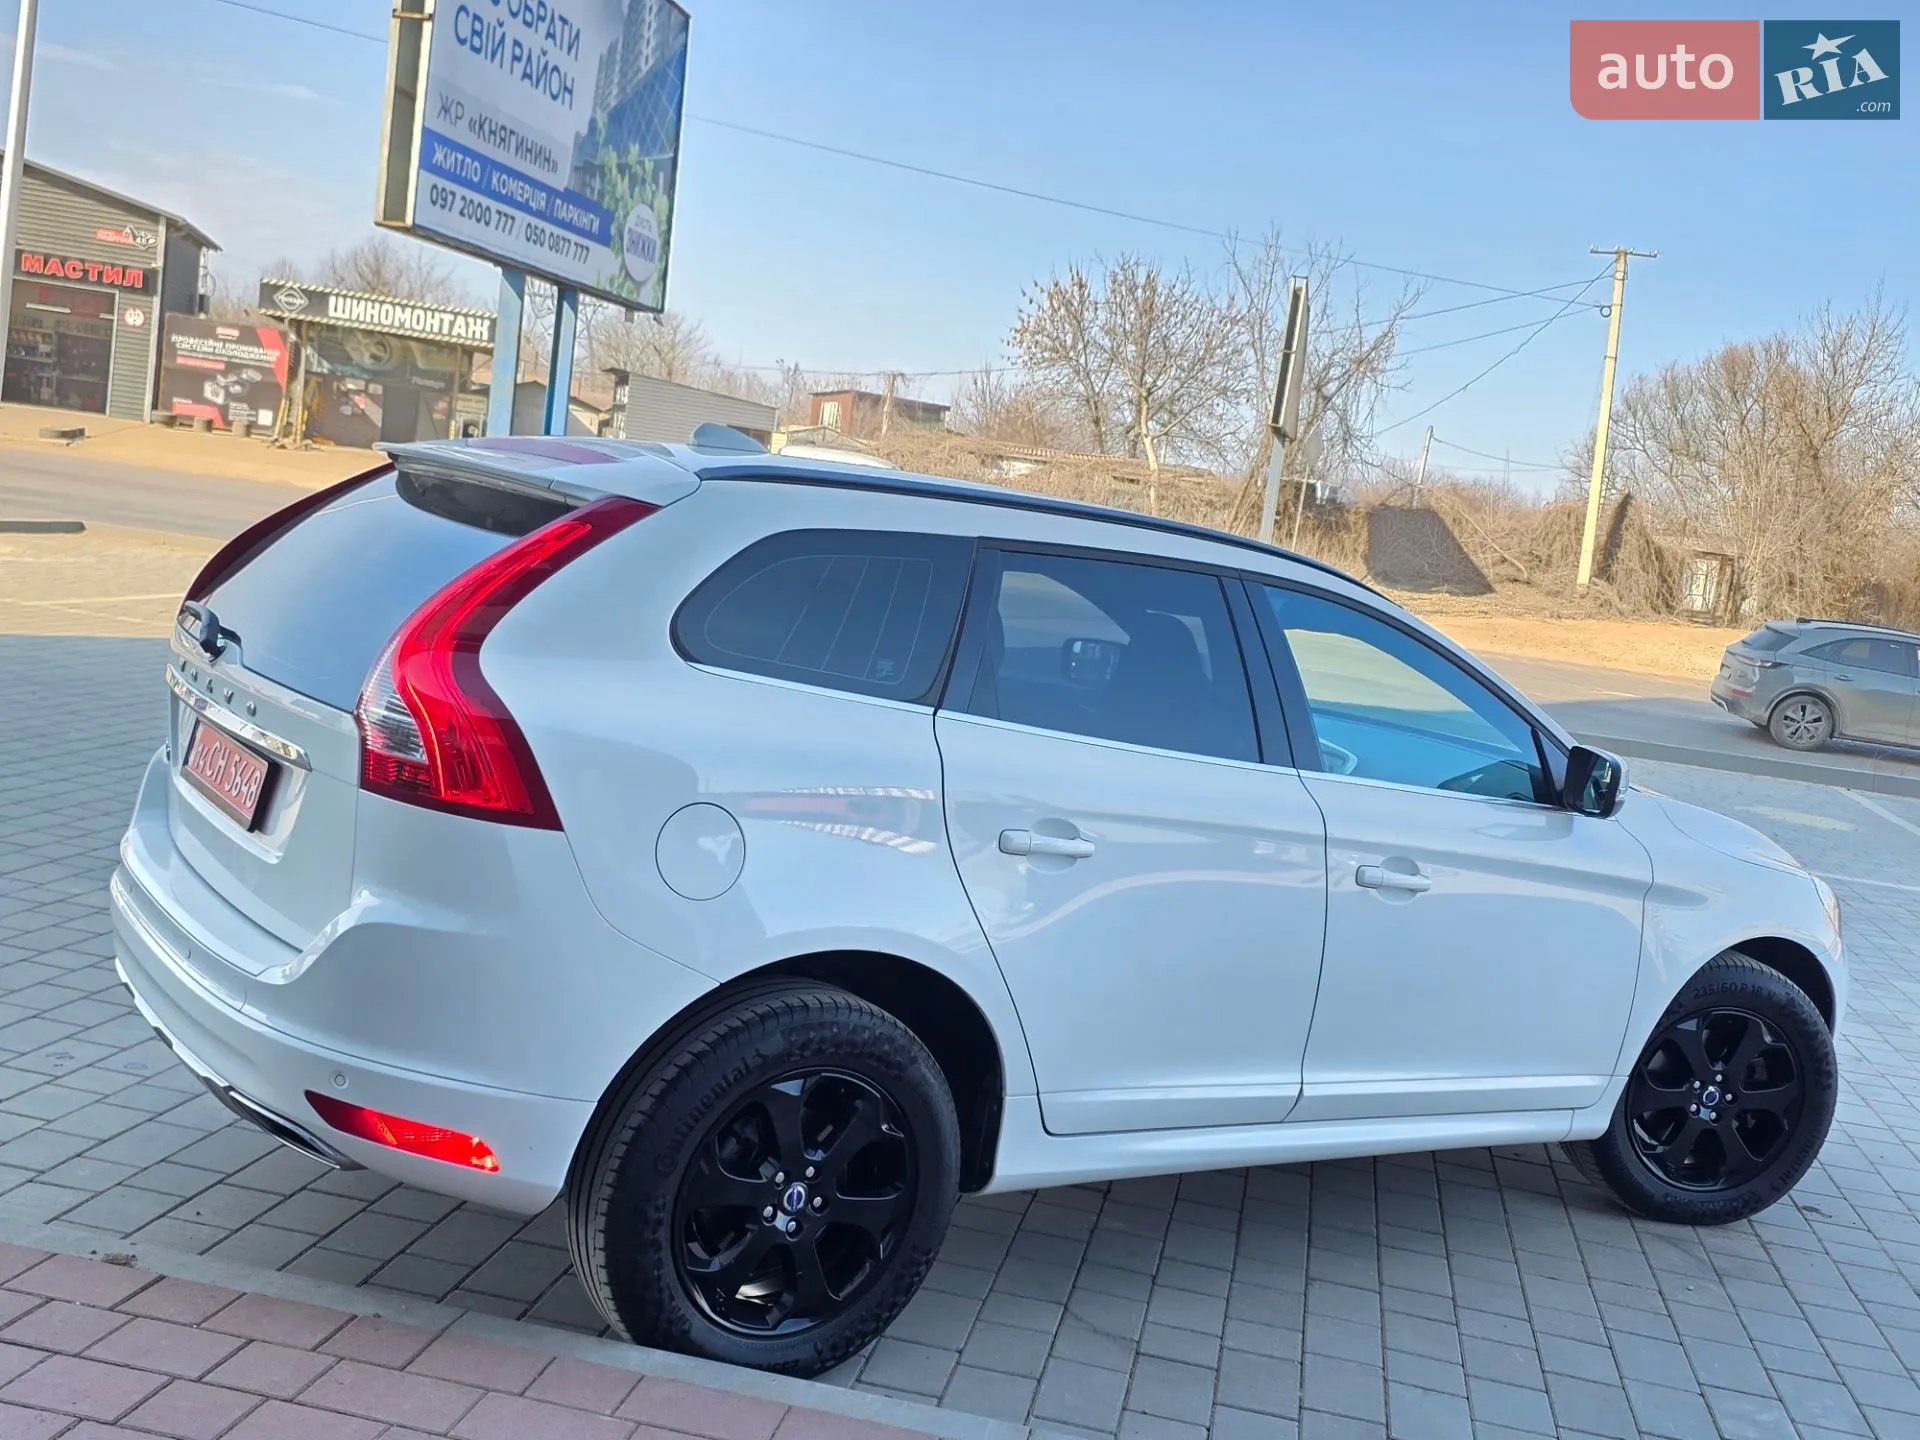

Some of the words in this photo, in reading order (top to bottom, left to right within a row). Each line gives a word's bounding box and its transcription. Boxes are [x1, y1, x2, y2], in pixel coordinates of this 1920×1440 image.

[454, 5, 506, 70] СВІЙ
[509, 38, 575, 110] РАЙОН
[437, 91, 465, 124] ЖР
[469, 113, 559, 174] «КНЯГИНИН»
[430, 183, 457, 212] 097
[459, 195, 491, 227] 2000
[496, 208, 516, 236] 777
[525, 222, 546, 249] 050
[548, 231, 571, 259] 0877
[573, 241, 591, 265] 777
[432, 143, 481, 183] ЖИТЛО
[491, 170, 547, 212] КОМЕРЦІЯ
[553, 198, 600, 235] ПАРКІНГИ
[21, 252, 144, 289] МАСТИЛ
[328, 295, 490, 341] ШИНОМОНТАЖ
[179, 657, 257, 717] VOLVO
[225, 755, 261, 810] 5648
[654, 1057, 752, 1179] Continental
